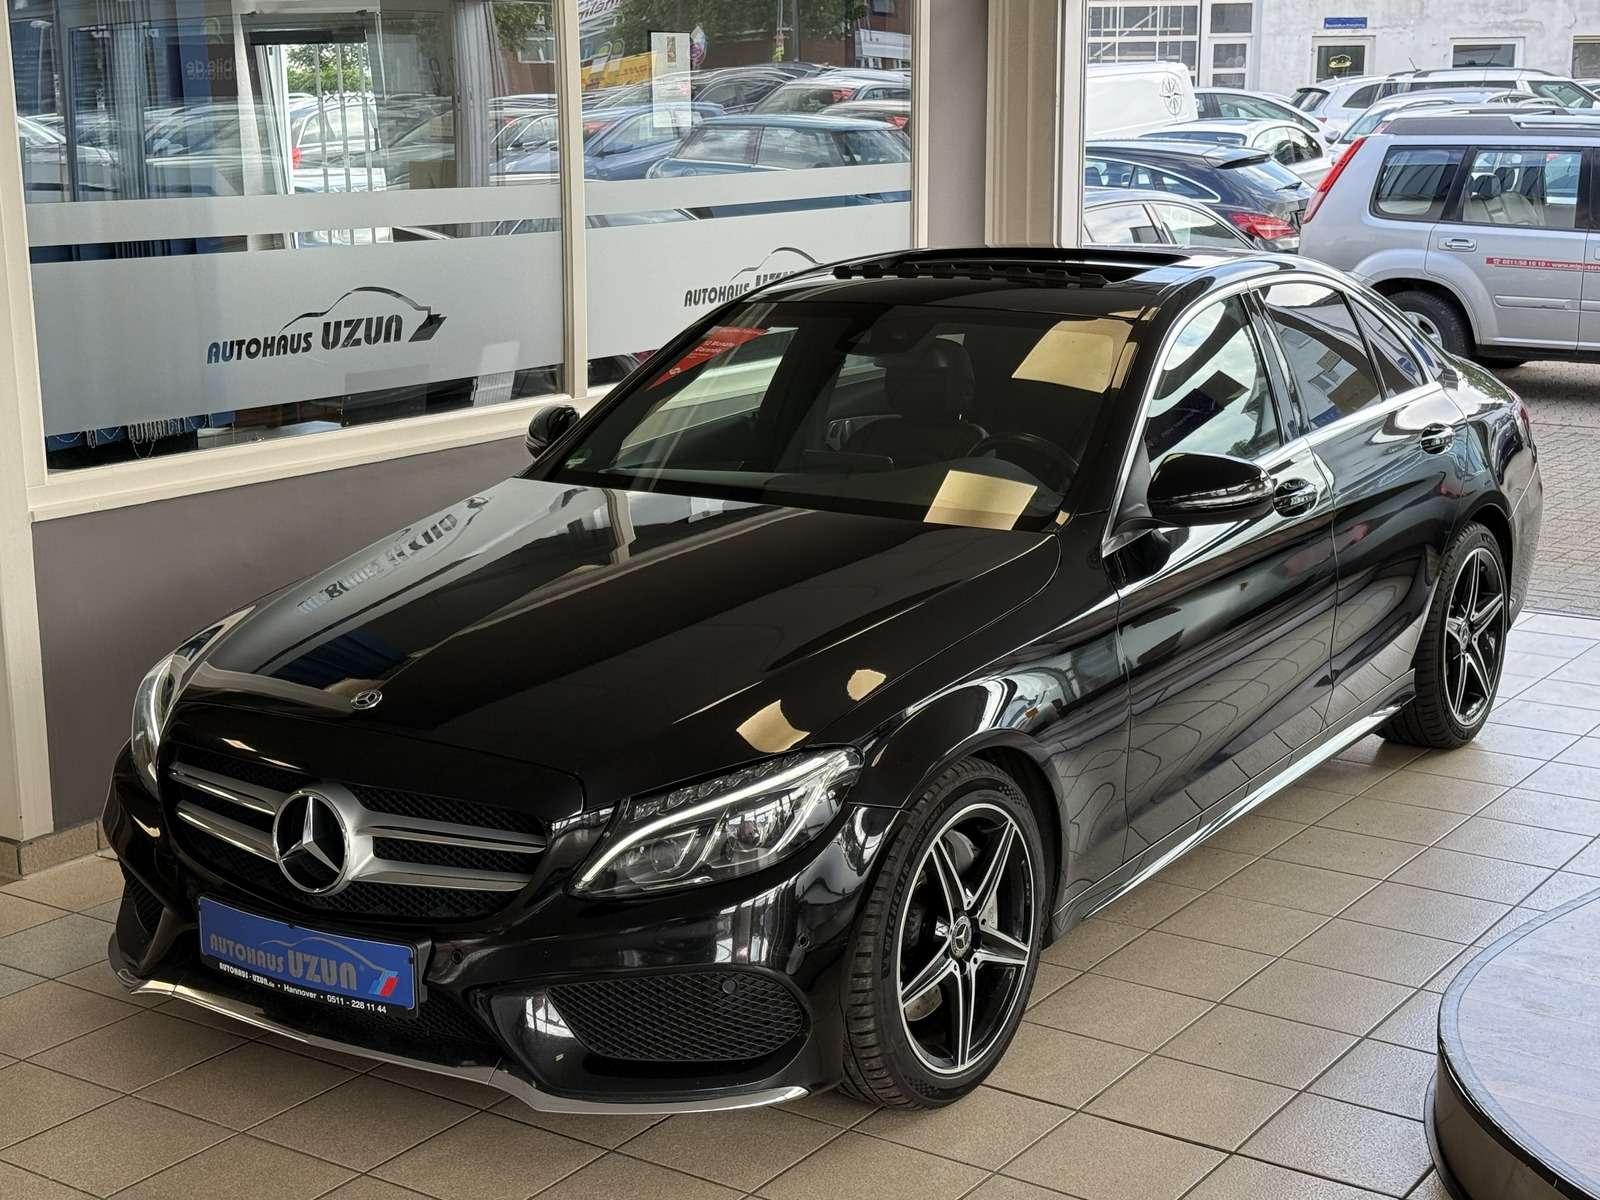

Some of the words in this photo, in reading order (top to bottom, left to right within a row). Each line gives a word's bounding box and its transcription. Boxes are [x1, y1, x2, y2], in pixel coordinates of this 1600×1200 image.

[206, 332, 313, 364] AUTOHAUS
[321, 314, 403, 350] UZUN
[209, 933, 284, 973] AUTOHAUS
[287, 949, 357, 991] UZUN
[219, 962, 249, 980] AUTOHAUS
[283, 983, 317, 1000] Hannover
[327, 994, 344, 1006] 0511
[351, 999, 364, 1010] 228
[366, 1003, 375, 1012] 11
[377, 1005, 387, 1014] 44
